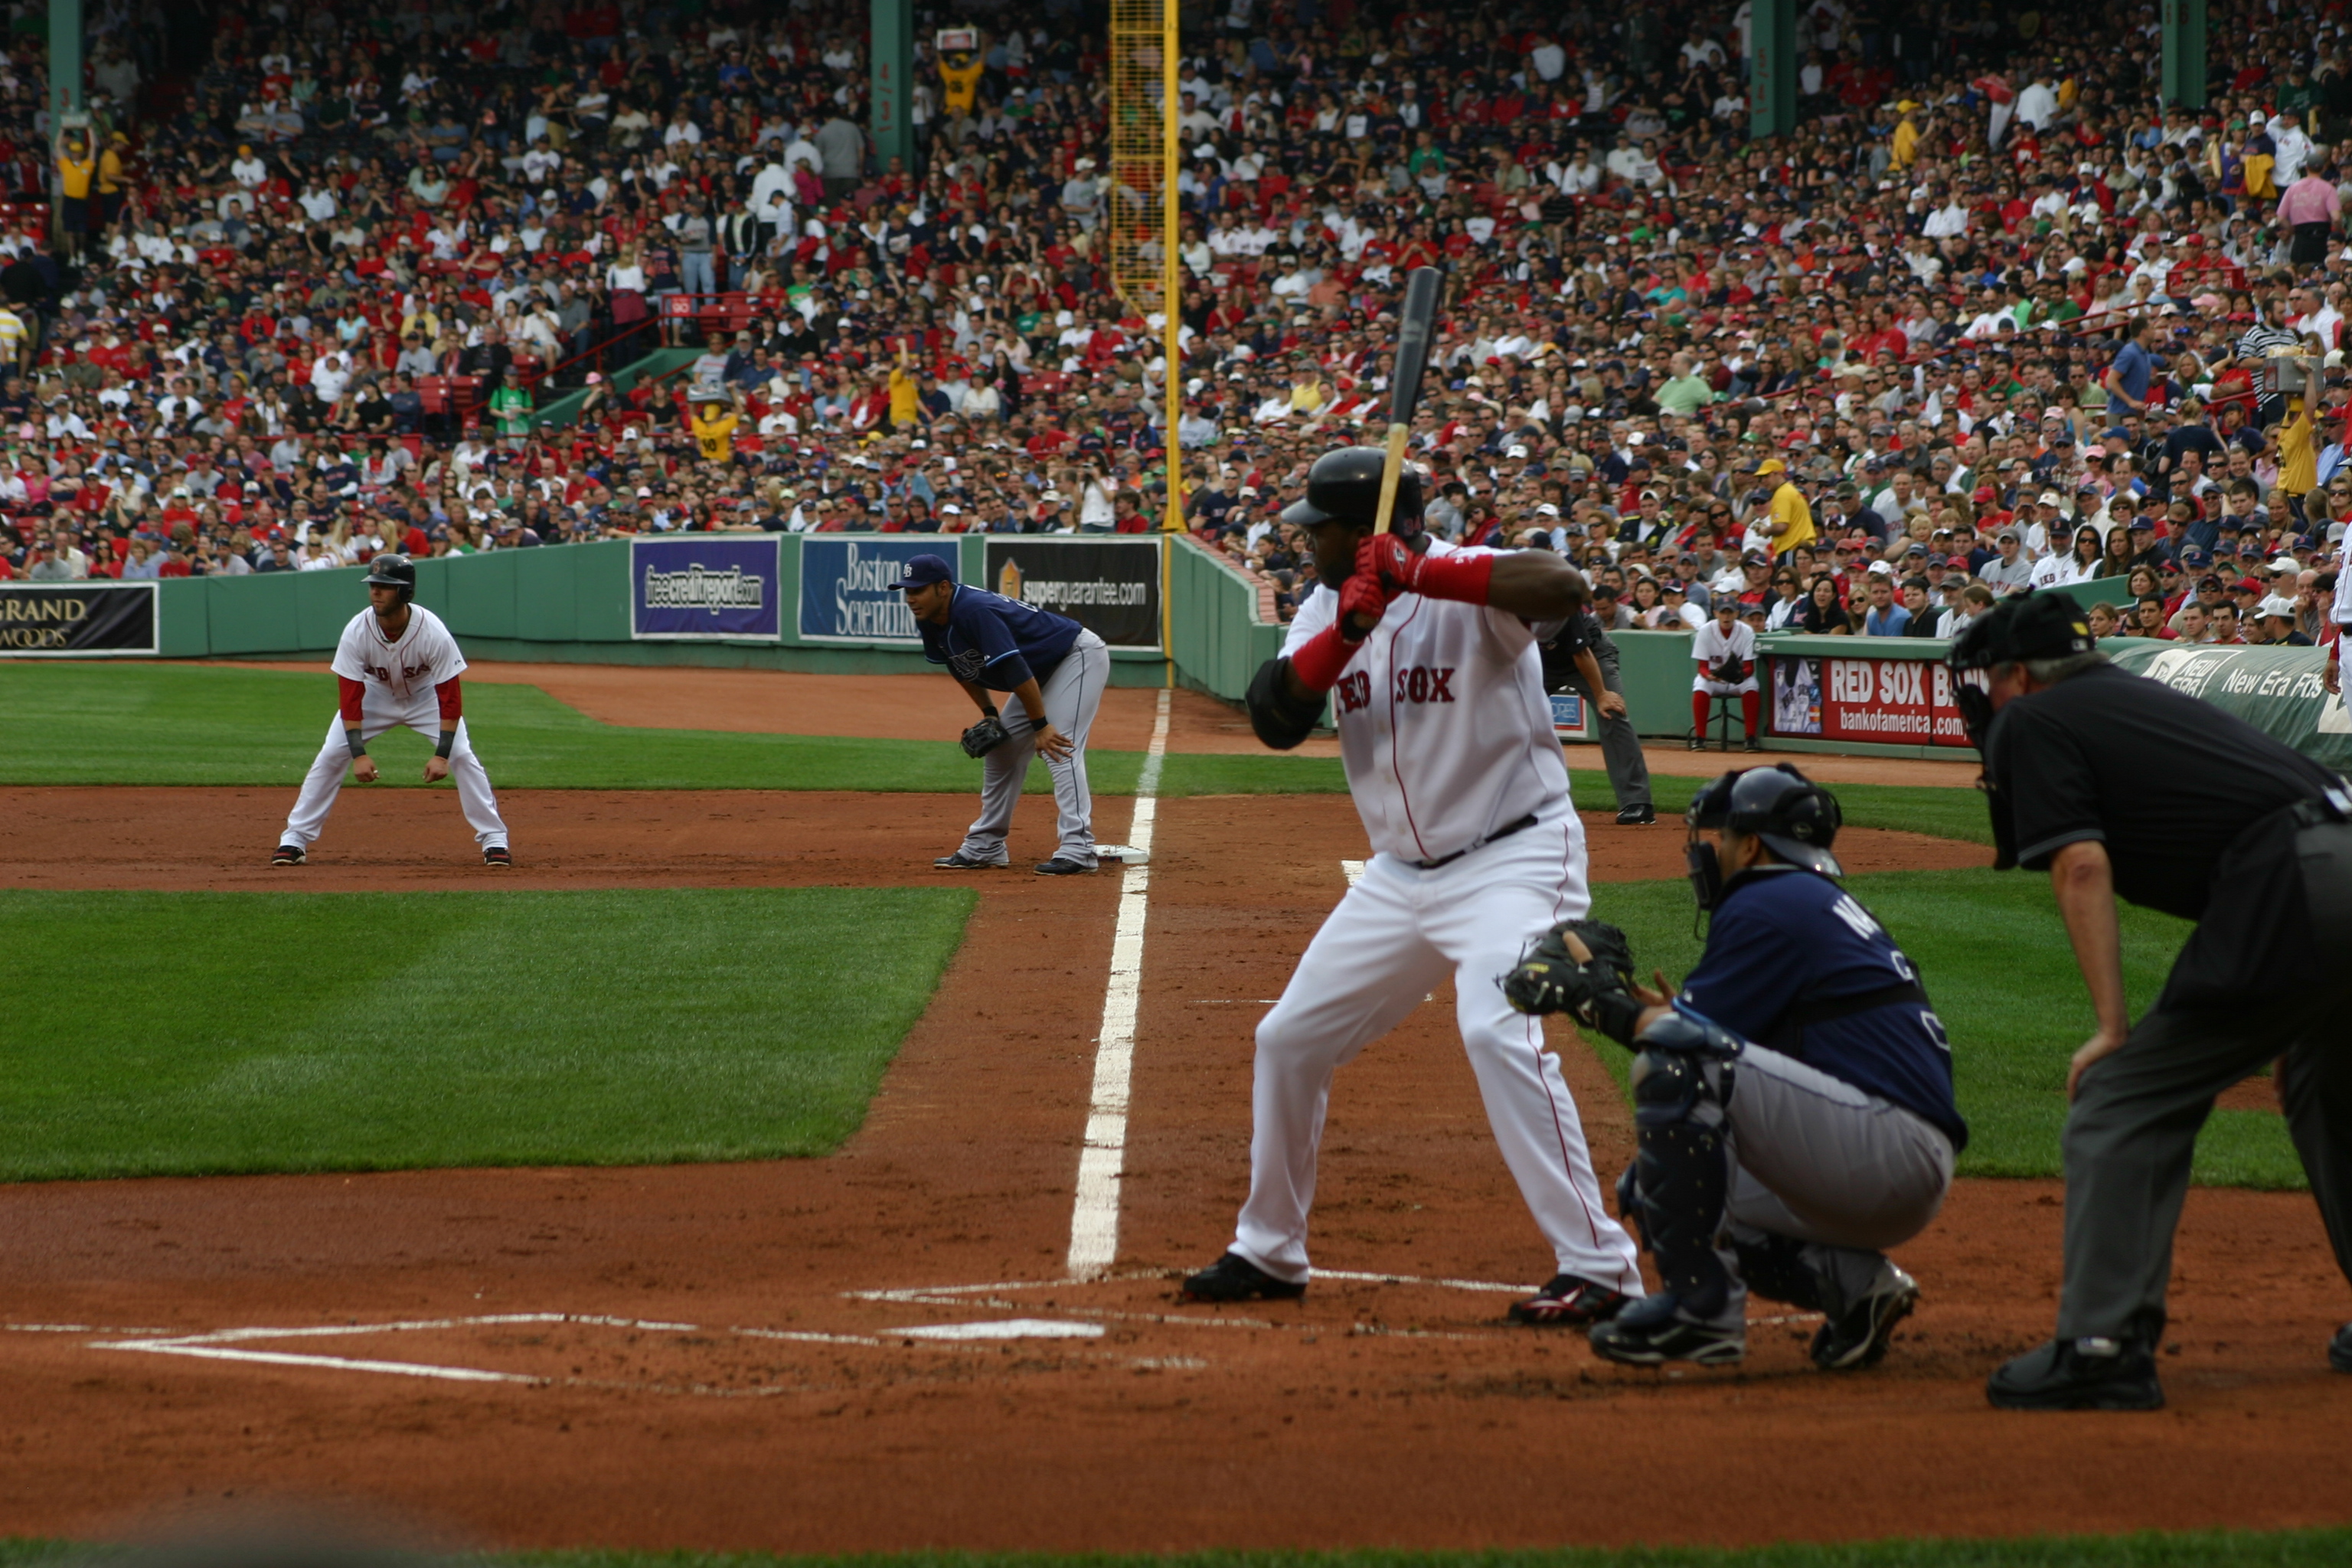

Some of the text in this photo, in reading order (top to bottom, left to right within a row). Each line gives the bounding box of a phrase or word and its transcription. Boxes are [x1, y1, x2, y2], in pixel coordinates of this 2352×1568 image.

[645, 563, 764, 615] freecreditreport.com
[848, 542, 901, 592] Boston
[0, 599, 87, 621] RAND
[1023, 577, 1147, 612] superguarantee.com
[1336, 666, 1455, 714] ED SOX
[1831, 660, 1873, 703] RED
[1879, 661, 1925, 705] SOX
[2221, 668, 2262, 694] New
[2257, 670, 2292, 697] Era
